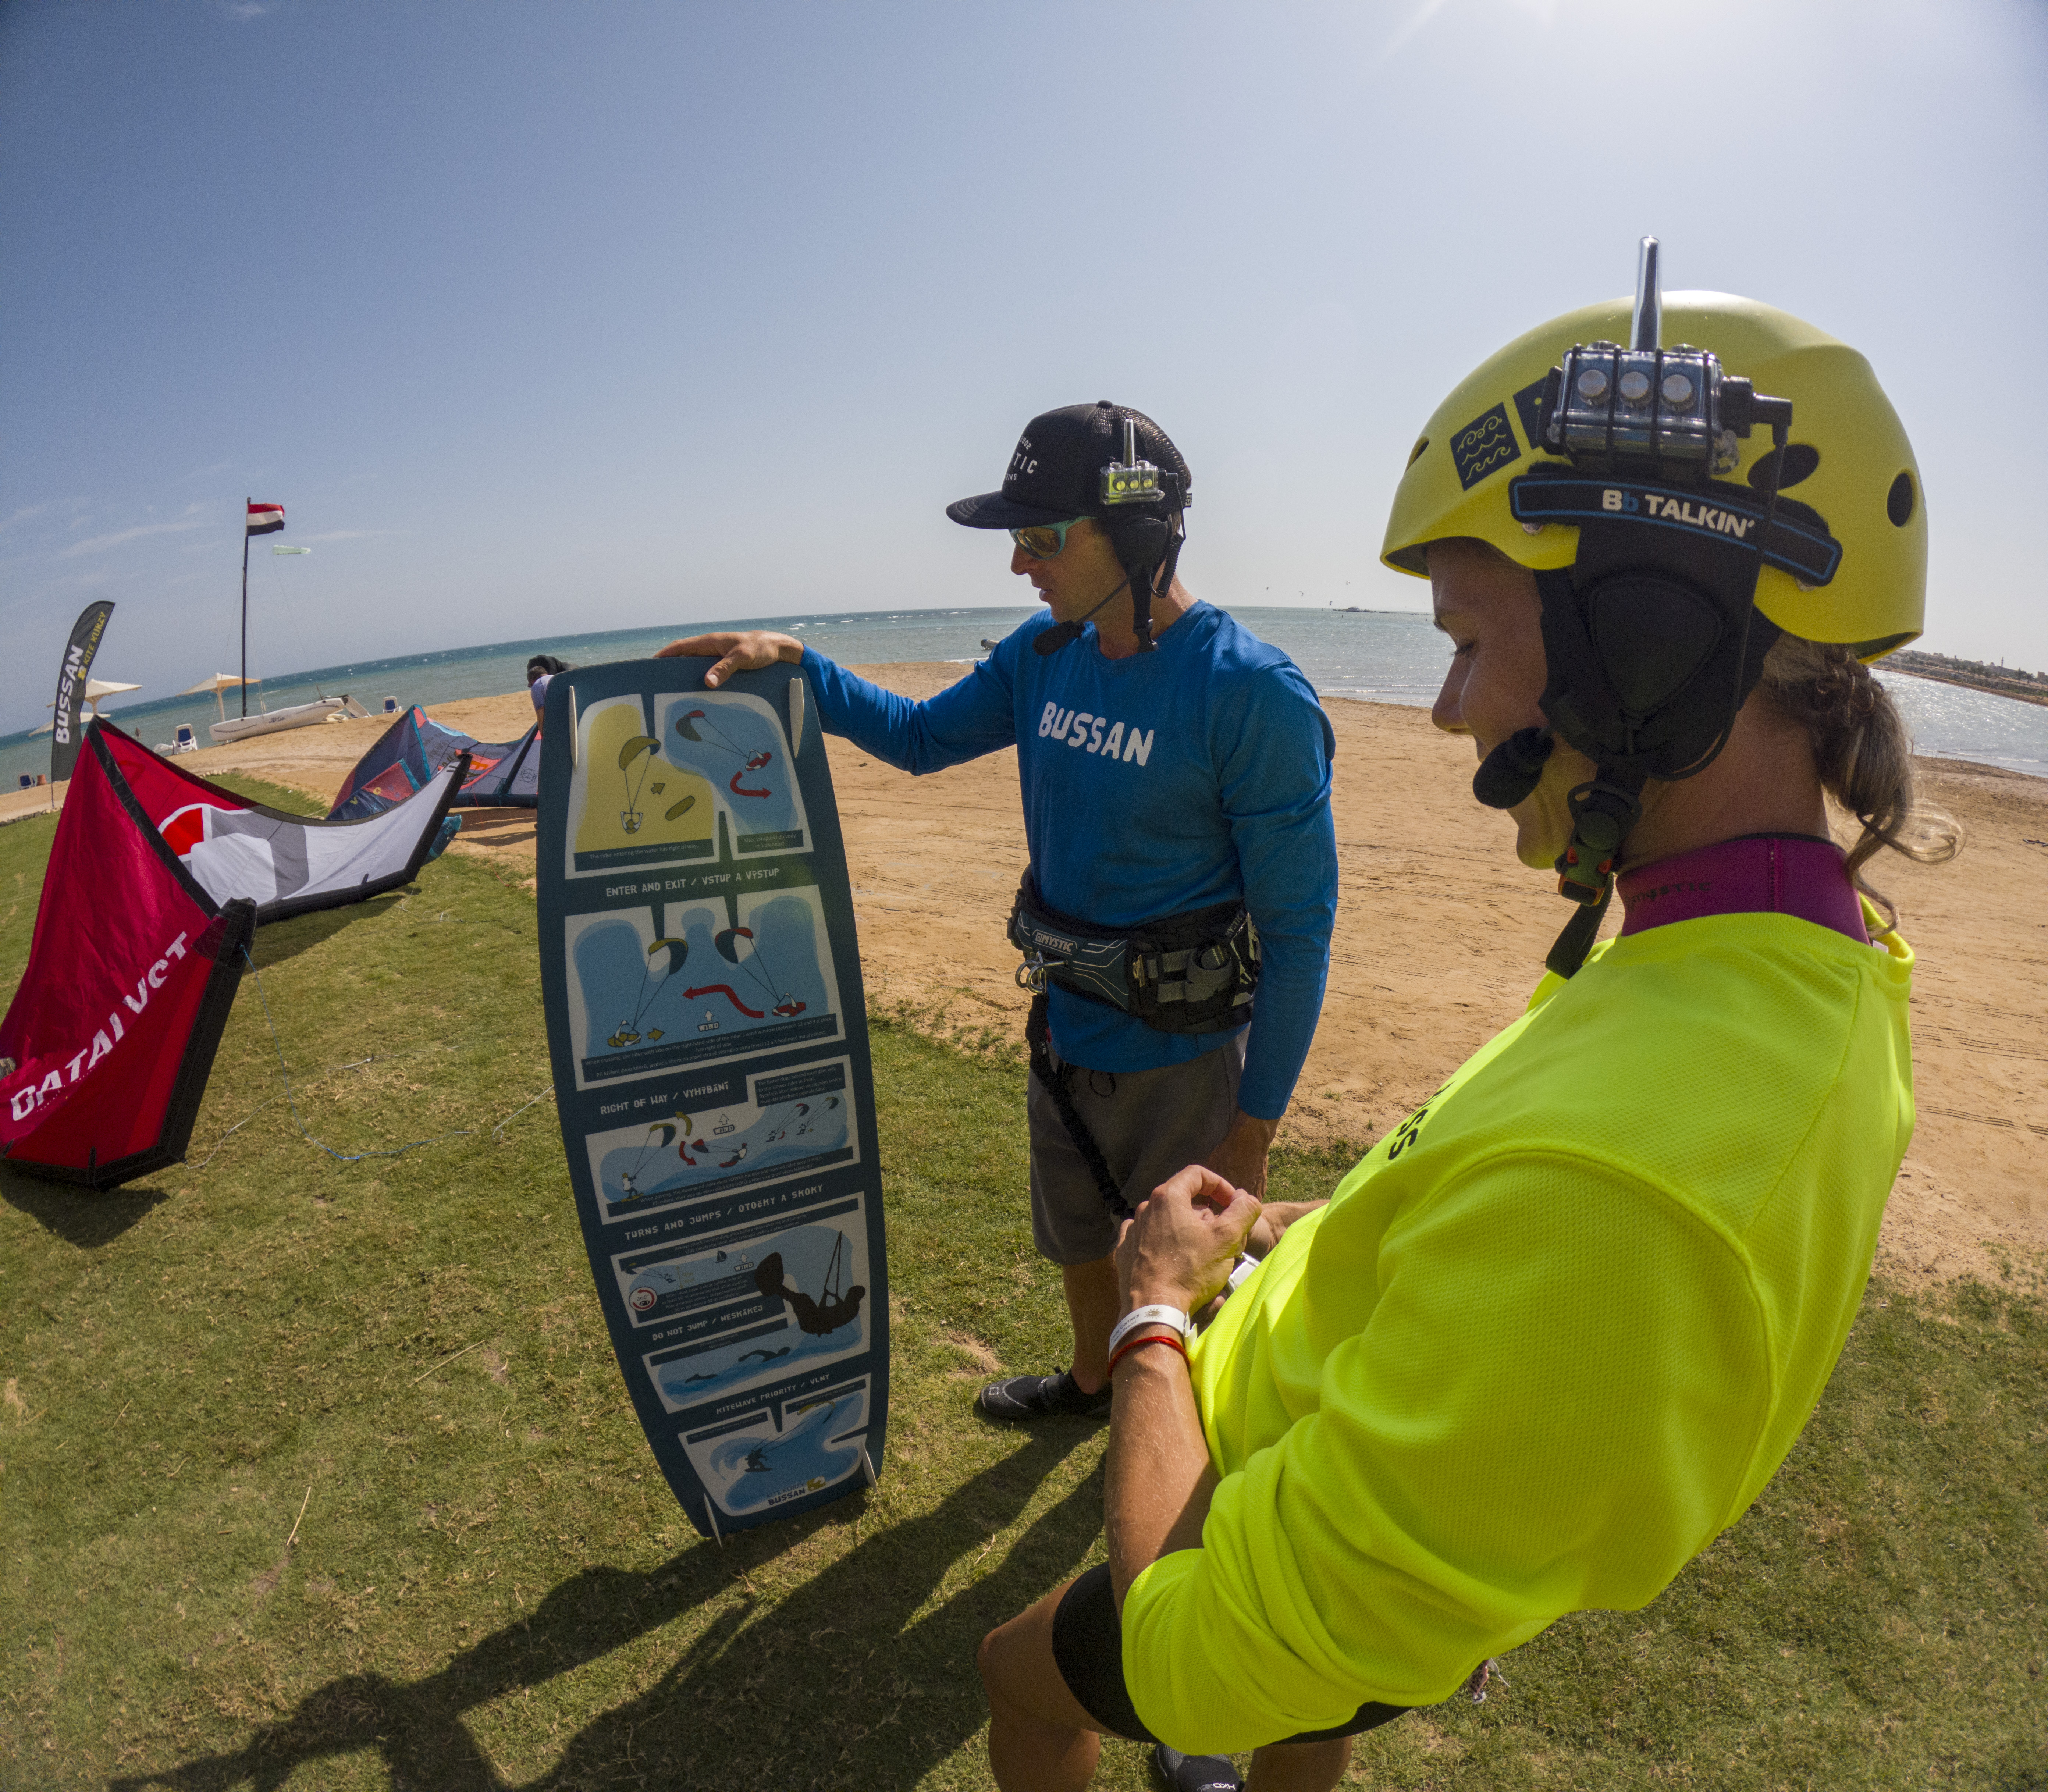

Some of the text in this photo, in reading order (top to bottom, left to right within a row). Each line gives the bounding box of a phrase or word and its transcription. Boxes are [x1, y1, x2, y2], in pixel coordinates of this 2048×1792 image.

[83, 611, 106, 665] KITE KURZY
[56, 645, 83, 744] BUSSAN
[1038, 701, 1155, 766] BUSSAN
[605, 885, 637, 897] ENTER
[641, 882, 661, 893] AND
[665, 878, 686, 890] EXIT
[701, 873, 731, 885] VSTUP
[736, 871, 742, 881] A
[1041, 934, 1073, 952] MYSTIC
[680, 1039, 705, 1049] right-hand
[776, 1023, 797, 1032] (between
[698, 1022, 719, 1031] WIND
[600, 1101, 629, 1115] RIGHT
[633, 1098, 646, 1108] OF
[651, 1094, 668, 1105] WAY
[714, 1125, 734, 1135] WIND
[624, 1226, 658, 1241] TURNS
[664, 1219, 683, 1231] AND
[689, 1210, 721, 1225] JUMPS
[738, 1196, 775, 1212] OTOČKY
[781, 1193, 787, 1202] A
[791, 1184, 823, 1199] SKOKY
[735, 1262, 753, 1272] WIND
[652, 1332, 664, 1341] DO
[666, 1326, 683, 1337] NOT
[687, 1320, 708, 1331] JUMP
[1120, 1314, 1139, 1329] Corners
[716, 1397, 757, 1415] KITEWAVE
[760, 1384, 796, 1401] PRIORITY
[809, 1373, 829, 1385] VLNY
[768, 1488, 805, 1506] BUSSAN
